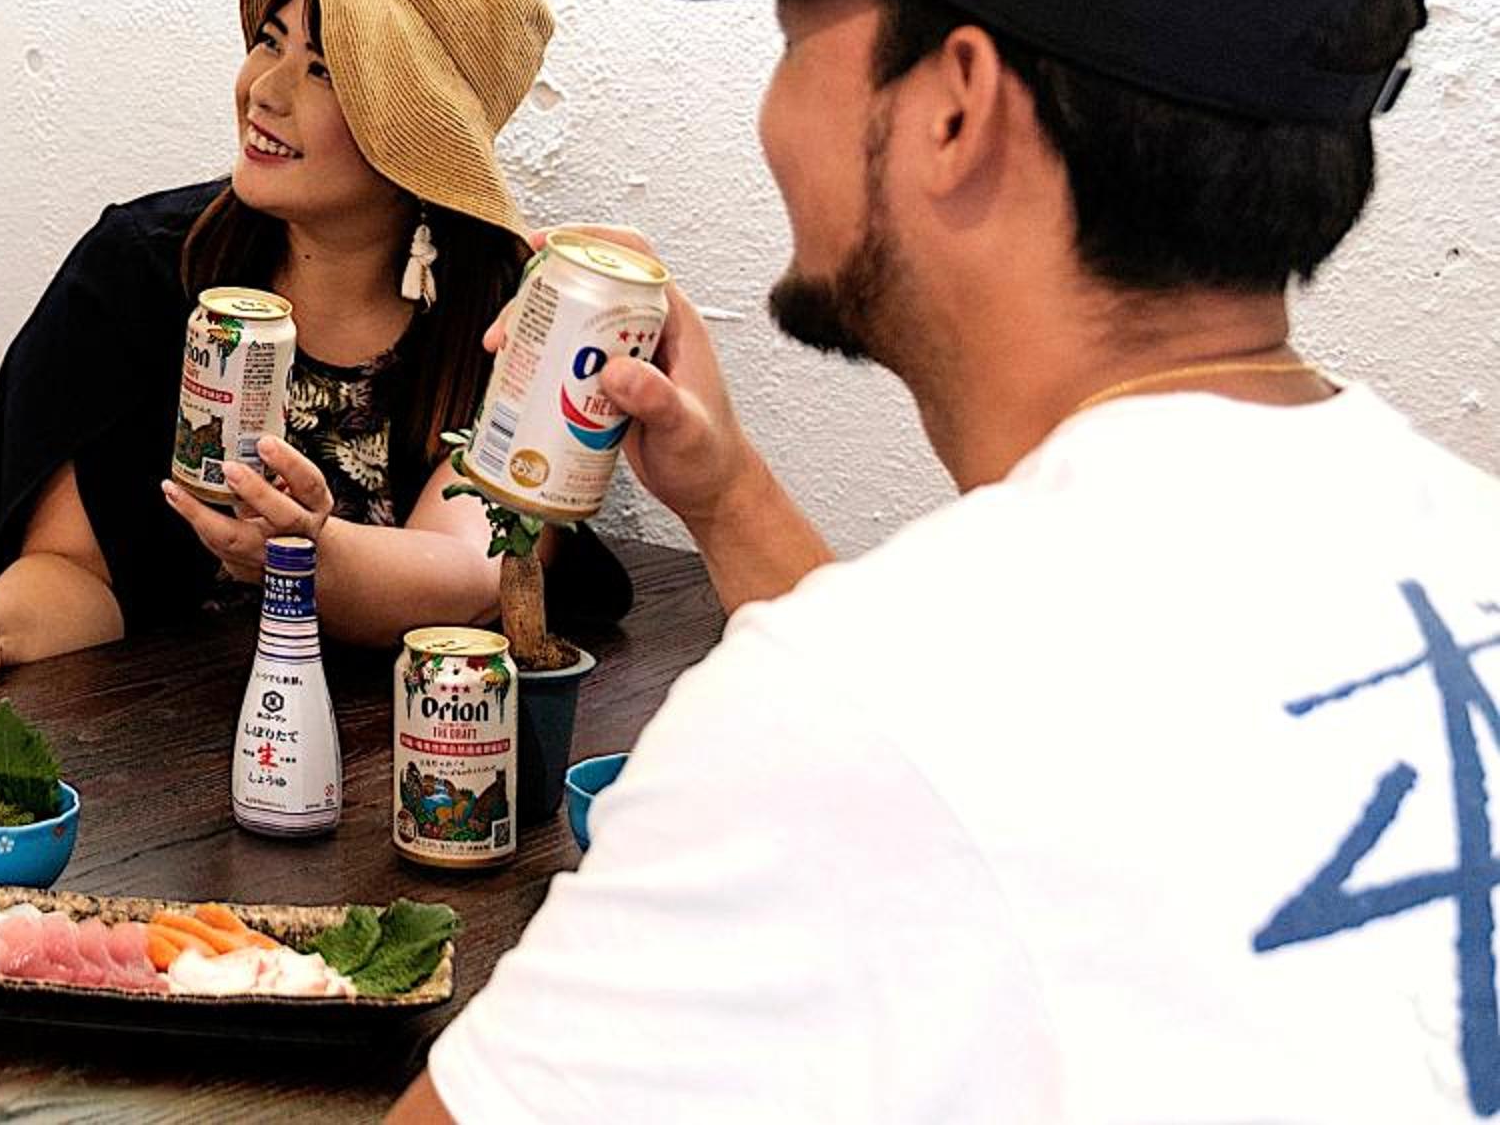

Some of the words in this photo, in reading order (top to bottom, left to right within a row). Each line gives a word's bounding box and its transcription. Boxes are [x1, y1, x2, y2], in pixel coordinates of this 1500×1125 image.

[421, 695, 489, 722] Orion
[244, 722, 299, 744] しぼりたて
[257, 742, 279, 768] 生
[247, 771, 287, 788] しょうゆ
